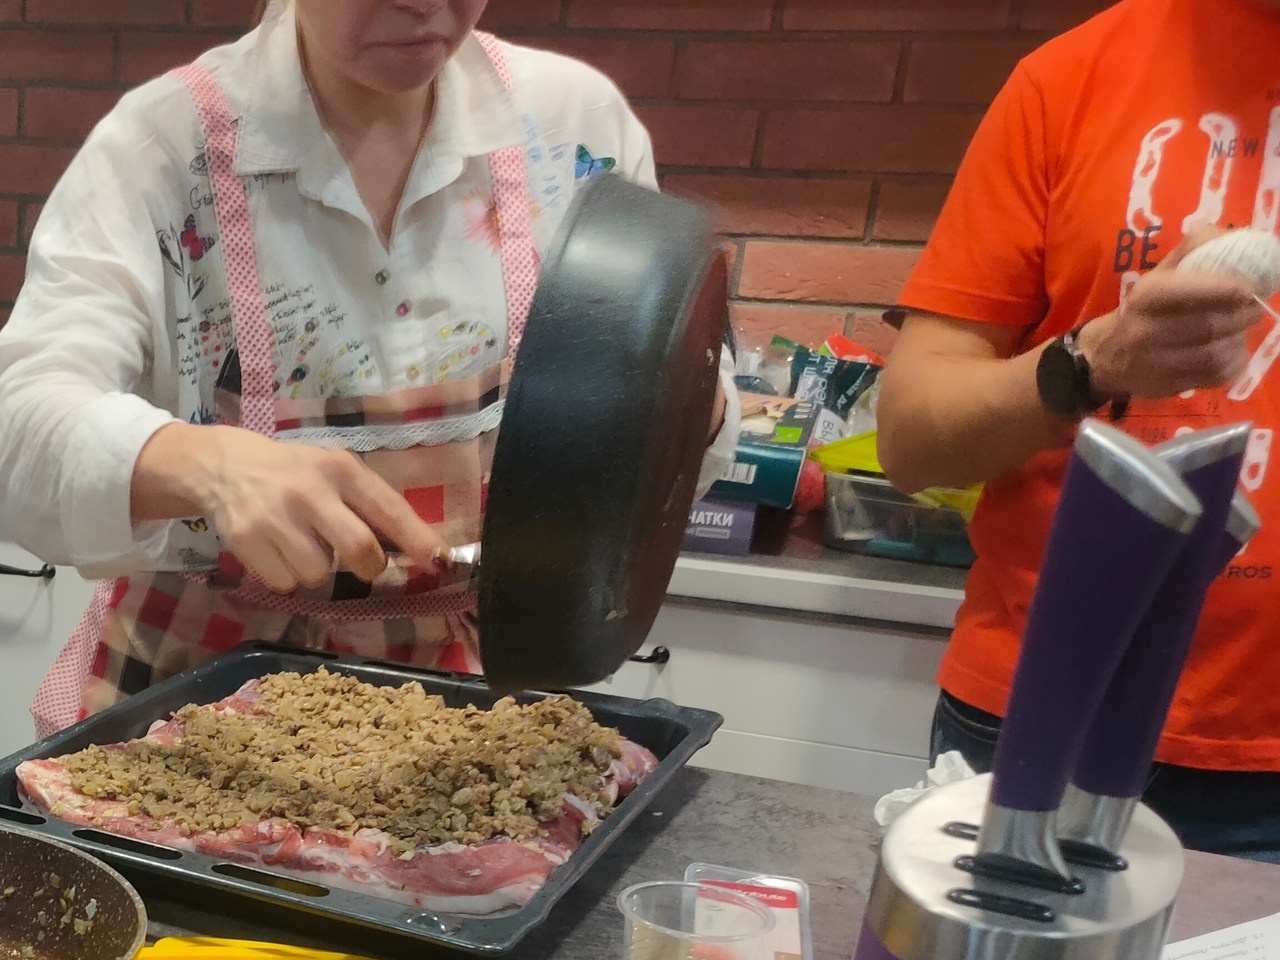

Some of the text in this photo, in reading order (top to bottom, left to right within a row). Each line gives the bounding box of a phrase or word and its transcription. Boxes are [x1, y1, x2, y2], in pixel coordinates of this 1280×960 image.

[1211, 139, 1259, 159] NEW
[1114, 225, 1162, 273] BE
[688, 510, 735, 526] ЧАТКИ
[1226, 566, 1272, 579] ROS
